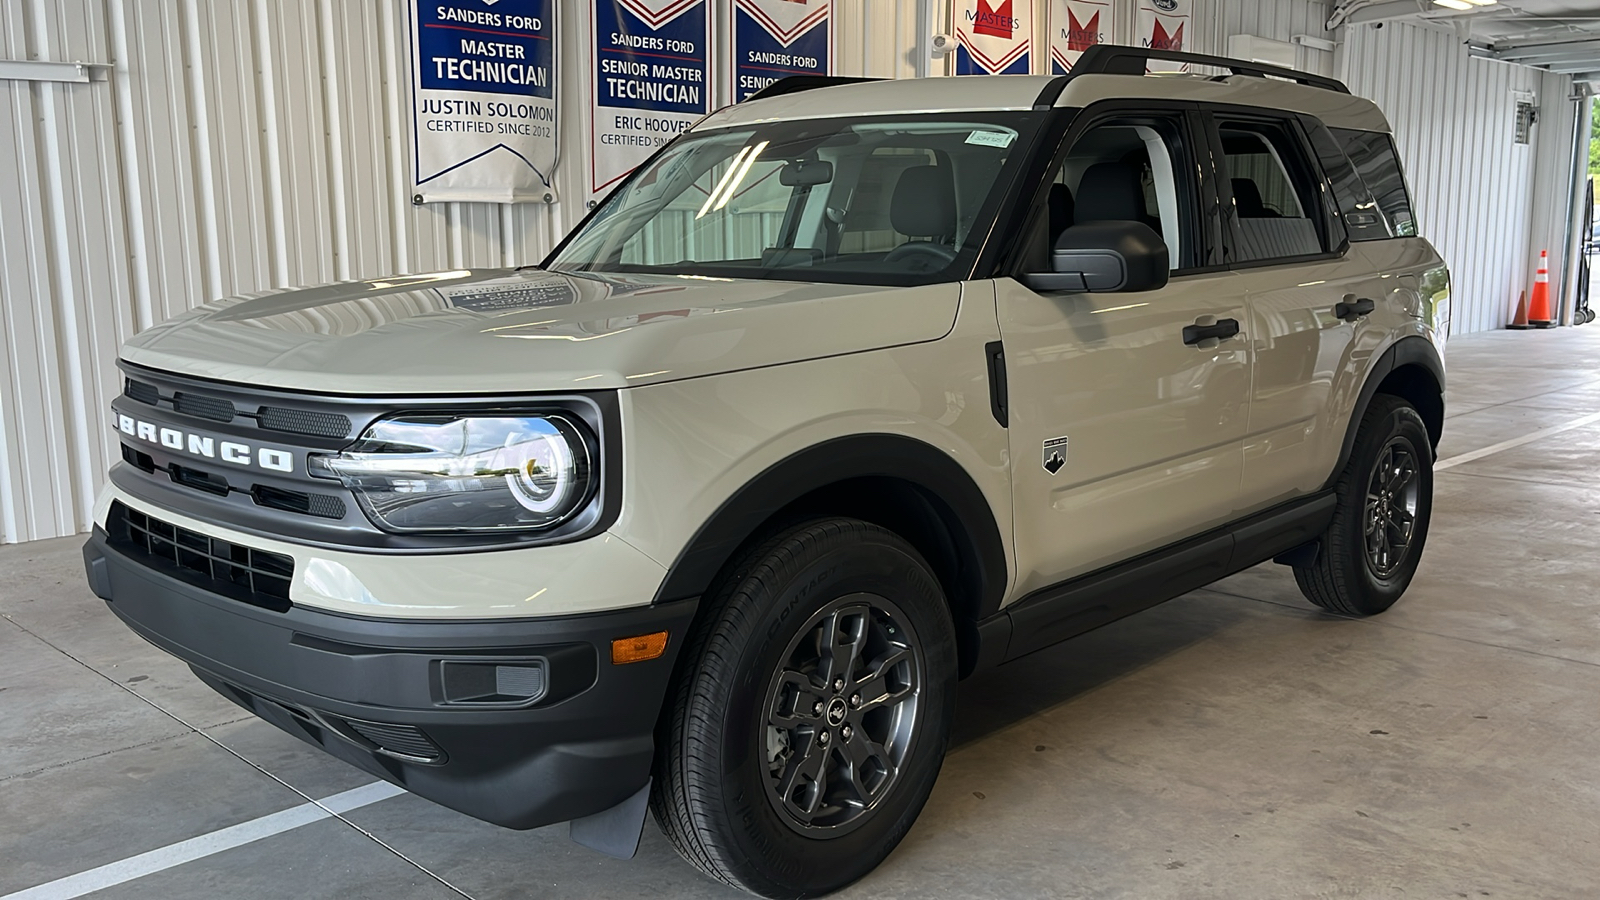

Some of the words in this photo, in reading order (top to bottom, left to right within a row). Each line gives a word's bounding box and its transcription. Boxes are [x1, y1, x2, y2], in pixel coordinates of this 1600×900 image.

[437, 6, 501, 27] SANDERS
[505, 15, 542, 31] FORD
[965, 9, 1020, 30] MASTERS
[461, 39, 525, 60] MASTER
[611, 32, 664, 50] SANDERS
[666, 39, 694, 54] FORD
[748, 50, 791, 66] SANDERS
[793, 55, 818, 69] FORD
[432, 57, 547, 88] TECHNICIAN
[601, 59, 649, 77] SENIOR
[652, 64, 703, 82] MASTER
[606, 78, 699, 105] TECHNICIAN
[740, 75, 780, 89] SENIO
[421, 99, 481, 116] JUSTIN
[487, 102, 553, 122] SOLOMON
[426, 120, 494, 133] CERTIFIED
[497, 122, 531, 136] SINCE
[532, 125, 551, 138] 2012
[615, 115, 642, 130] ERIC
[601, 133, 652, 147] CERTIFIED
[654, 136, 673, 147] SIN
[119, 413, 294, 473] BRONCO
